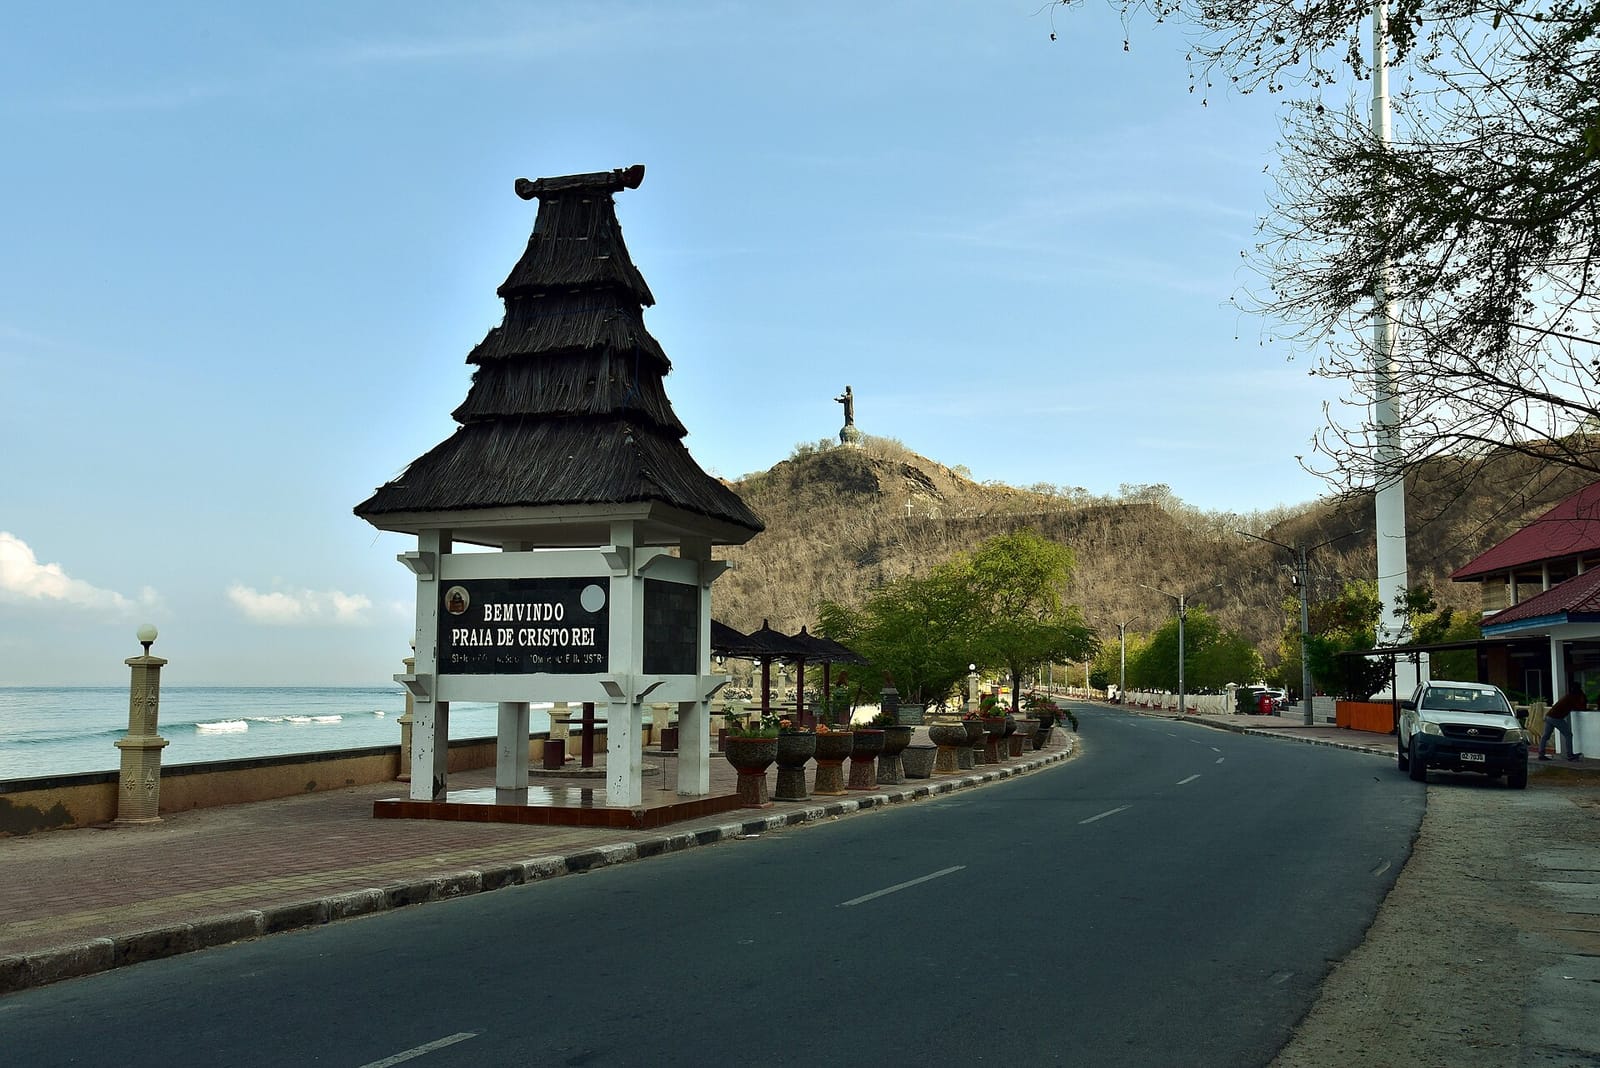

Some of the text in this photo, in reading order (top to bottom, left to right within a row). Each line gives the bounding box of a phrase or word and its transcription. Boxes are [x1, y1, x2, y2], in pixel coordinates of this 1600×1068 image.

[483, 602, 564, 622] BEMVINDO
[451, 627, 595, 647] PRAIA DE CRISTO REI
